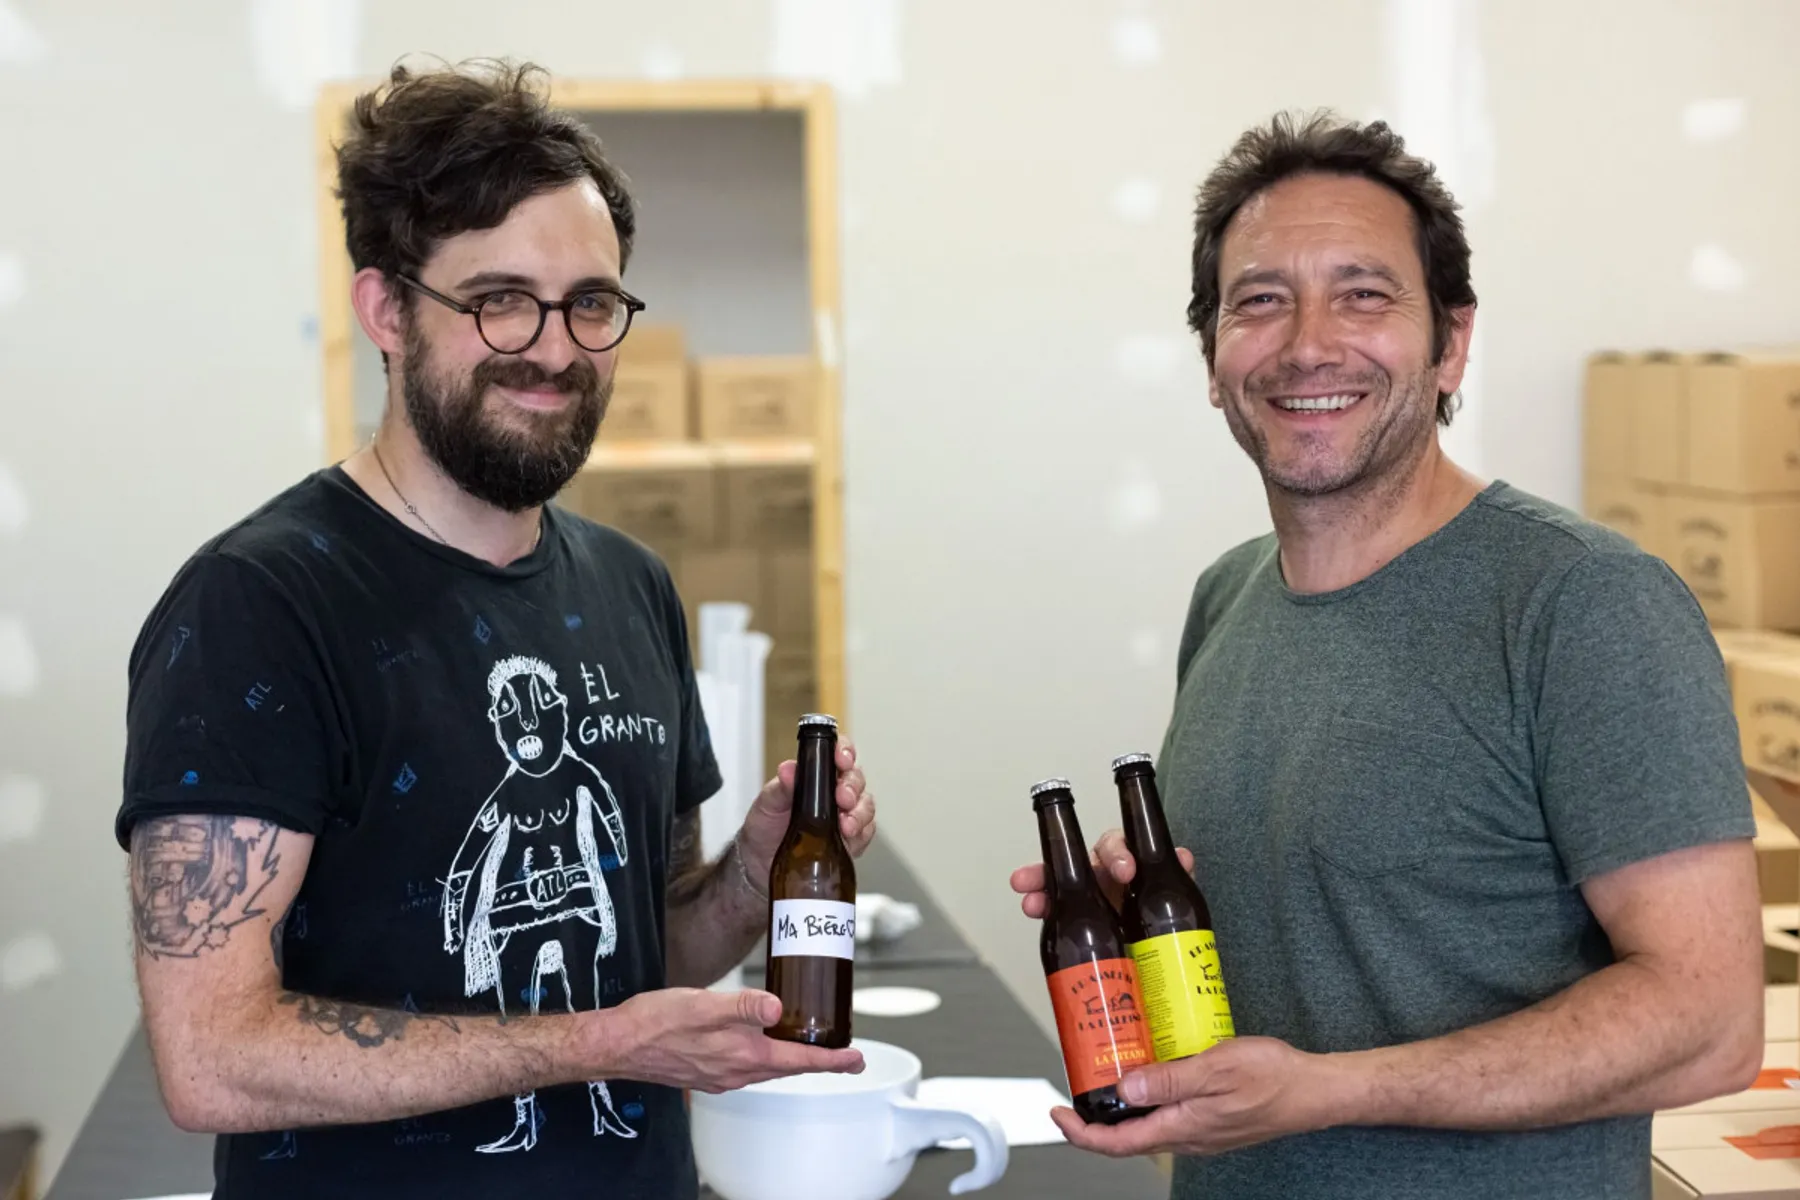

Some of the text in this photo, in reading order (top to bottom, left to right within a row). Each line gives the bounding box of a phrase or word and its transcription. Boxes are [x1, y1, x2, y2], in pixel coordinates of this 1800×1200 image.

[244, 681, 272, 711] ATL
[580, 661, 620, 704] EL
[579, 712, 665, 745] GRANTO
[537, 872, 564, 901] ATL
